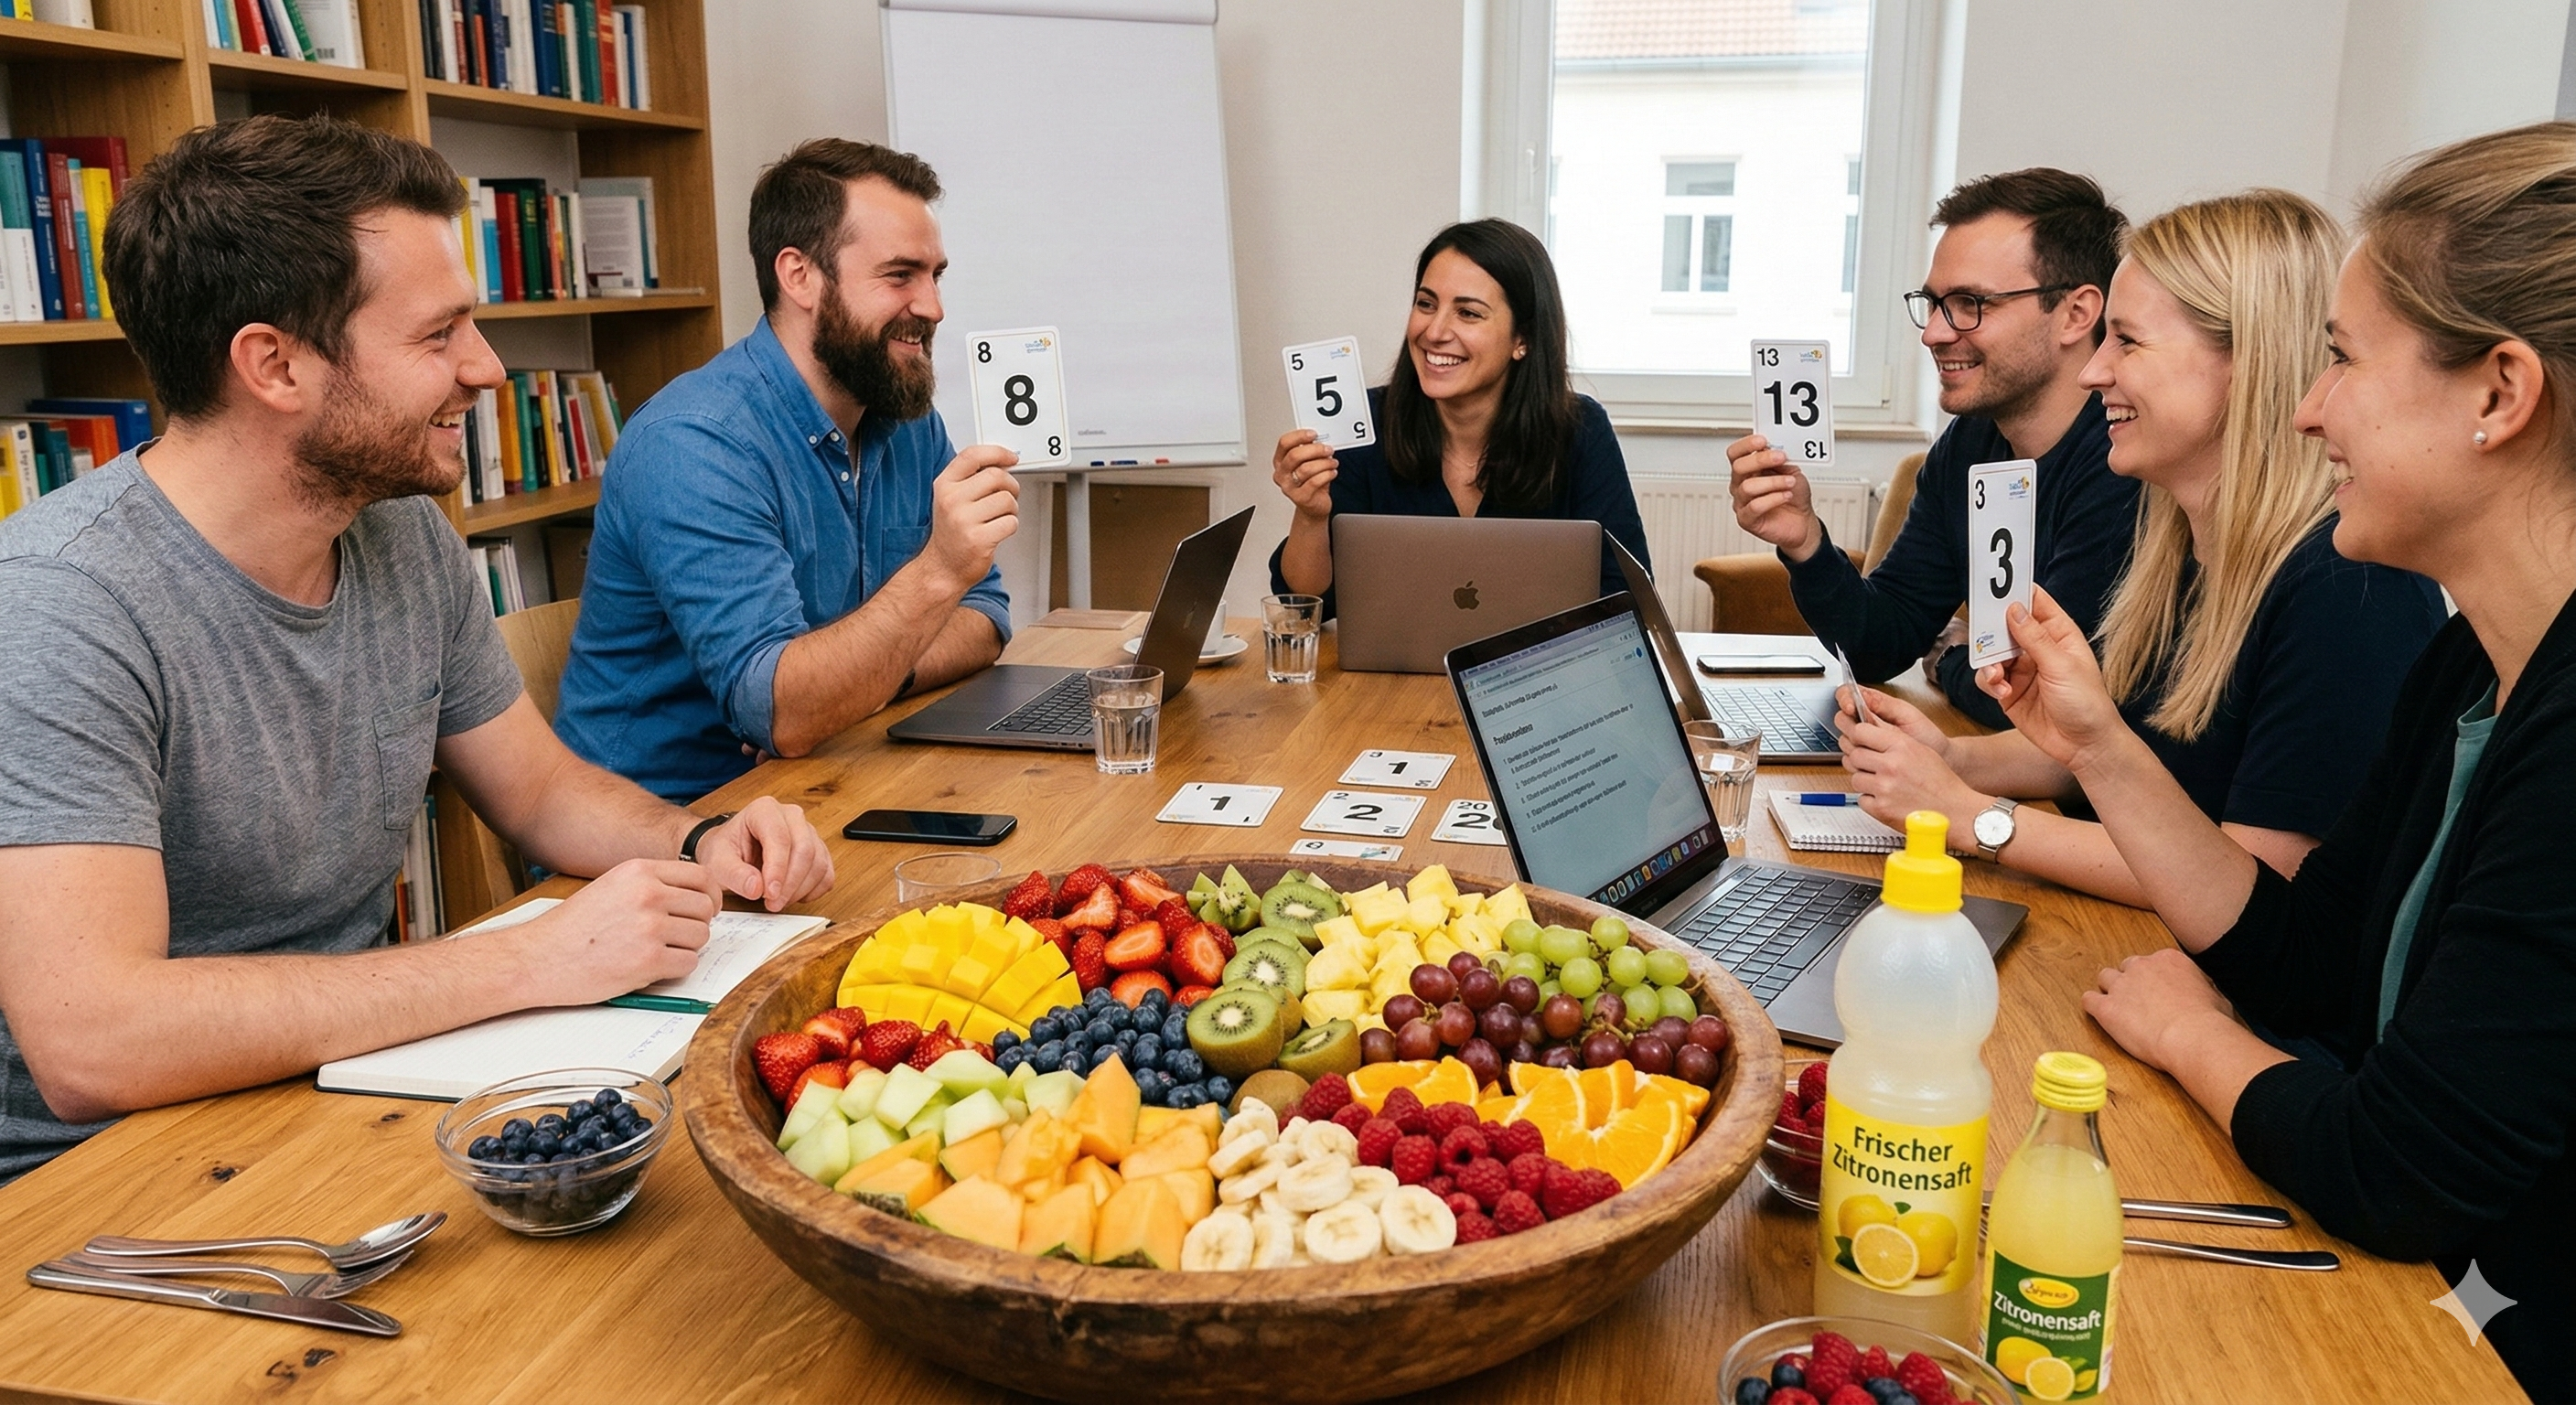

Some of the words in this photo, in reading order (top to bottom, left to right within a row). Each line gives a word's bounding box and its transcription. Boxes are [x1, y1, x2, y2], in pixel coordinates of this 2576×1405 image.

[977, 341, 993, 364] 8
[1291, 352, 1304, 371] 5
[1756, 348, 1780, 367] 13
[1004, 374, 1038, 426] 8
[1315, 375, 1343, 417] 5
[1763, 380, 1820, 427] 13
[1353, 421, 1367, 440] 5
[1047, 435, 1062, 456] 8
[1804, 440, 1828, 459] 13
[1974, 478, 1986, 510] 3
[1990, 527, 2013, 599] 3
[1388, 761, 1409, 775] 1
[1209, 796, 1232, 811] 1
[1332, 792, 1350, 800] 2
[1456, 801, 1488, 811] 20
[1343, 804, 1384, 821] 2
[1853, 1125, 1954, 1163] Frischer
[1832, 1143, 1972, 1191] Zitronensaft
[1993, 1290, 2102, 1332] Zitronensaft
